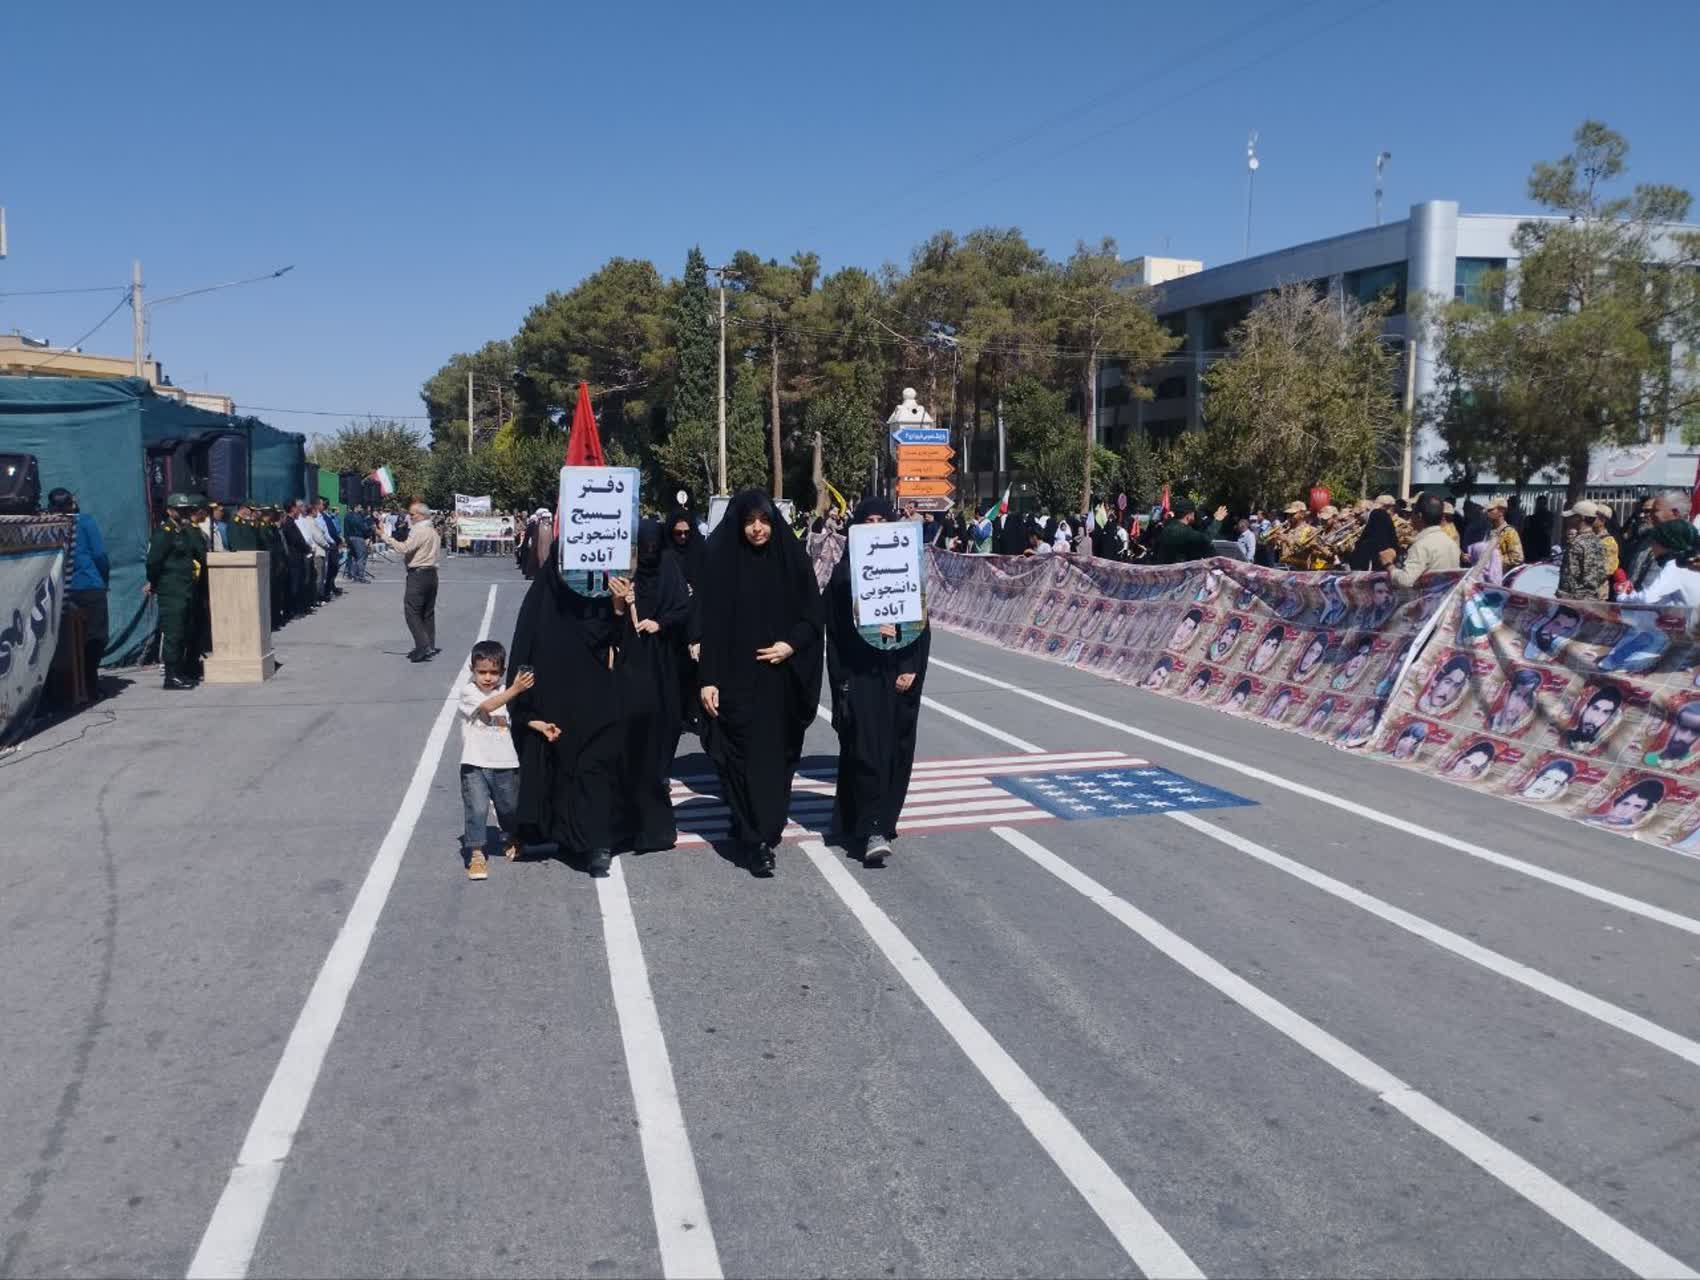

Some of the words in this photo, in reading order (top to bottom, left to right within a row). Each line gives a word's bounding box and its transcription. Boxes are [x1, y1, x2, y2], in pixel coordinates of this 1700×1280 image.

[578, 475, 625, 498] دفتر
[571, 508, 621, 524] بسیج
[567, 527, 629, 545] دانشجویی
[866, 531, 910, 555] دفتر
[580, 547, 614, 566] آباده
[862, 562, 909, 580] بسیج
[860, 580, 917, 600] دانشجویی
[874, 600, 906, 619] آباده
